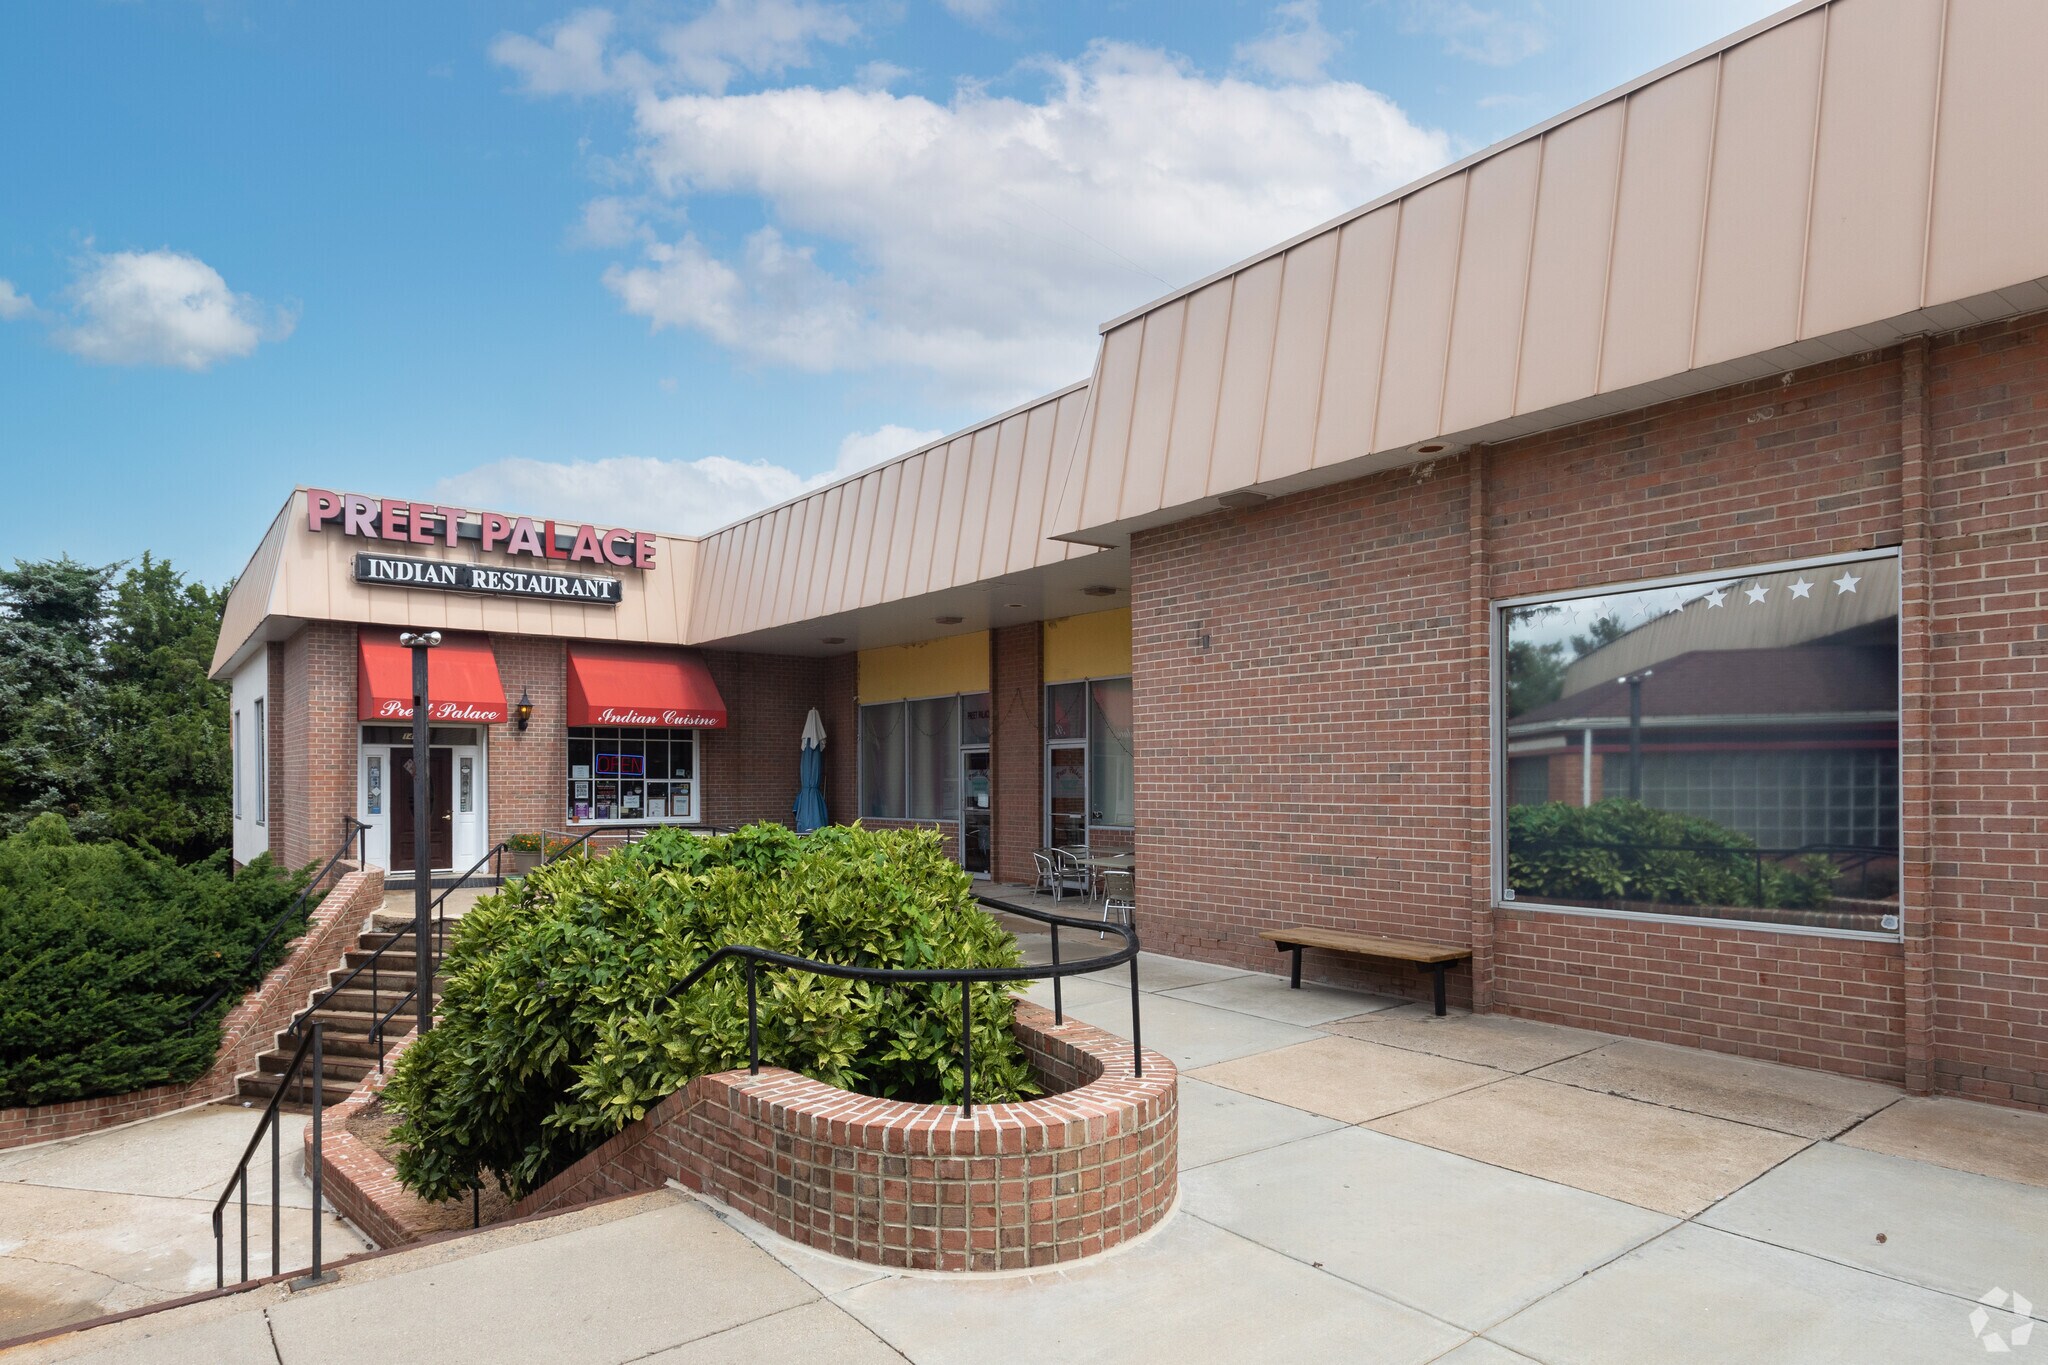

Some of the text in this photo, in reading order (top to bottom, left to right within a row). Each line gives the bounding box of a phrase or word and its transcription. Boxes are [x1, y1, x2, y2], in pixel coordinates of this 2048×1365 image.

[307, 488, 656, 570] PREET PALACE
[368, 558, 612, 598] INDIAN RESTAURANT
[380, 700, 500, 720] Pret Palace
[598, 708, 719, 726] Indian Cuisine
[598, 756, 643, 773] OPEN
